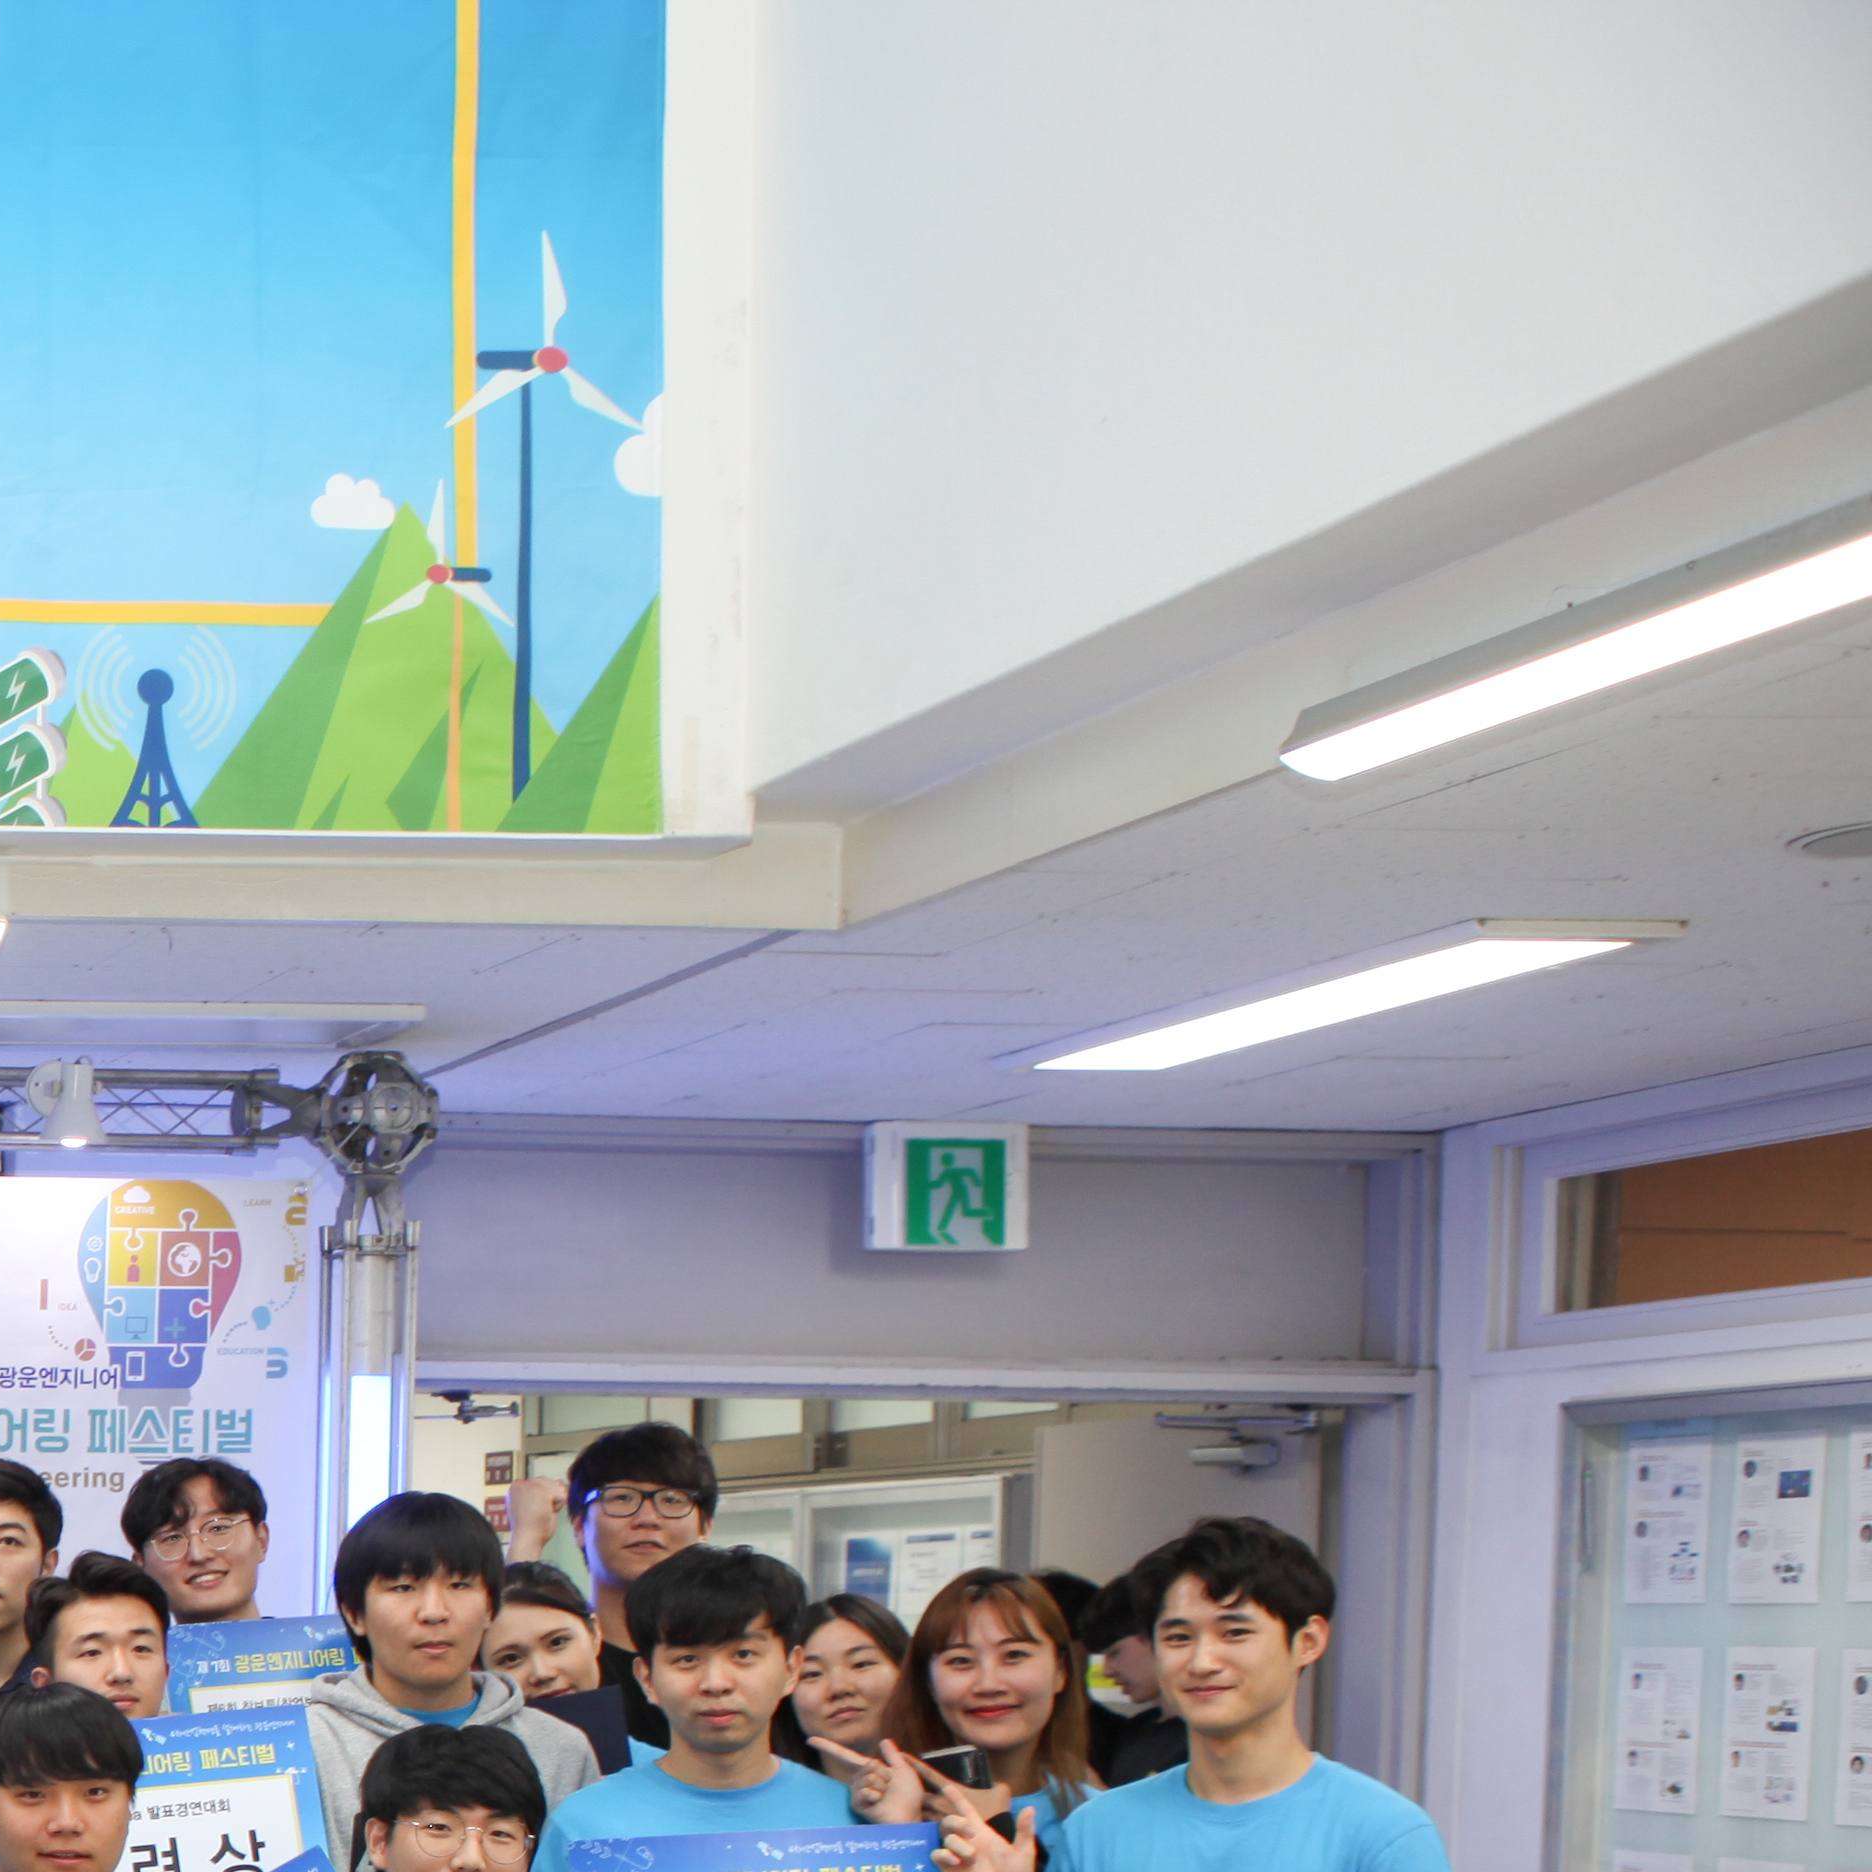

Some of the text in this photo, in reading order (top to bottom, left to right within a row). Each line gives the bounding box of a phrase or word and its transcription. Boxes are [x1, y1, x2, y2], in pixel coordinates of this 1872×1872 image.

[115, 1206, 155, 1215] CREATIVE
[217, 1348, 264, 1356] EDUCATION
[87, 1406, 253, 1455] 페스티벌
[147, 1798, 231, 1820] 발표경연대회
